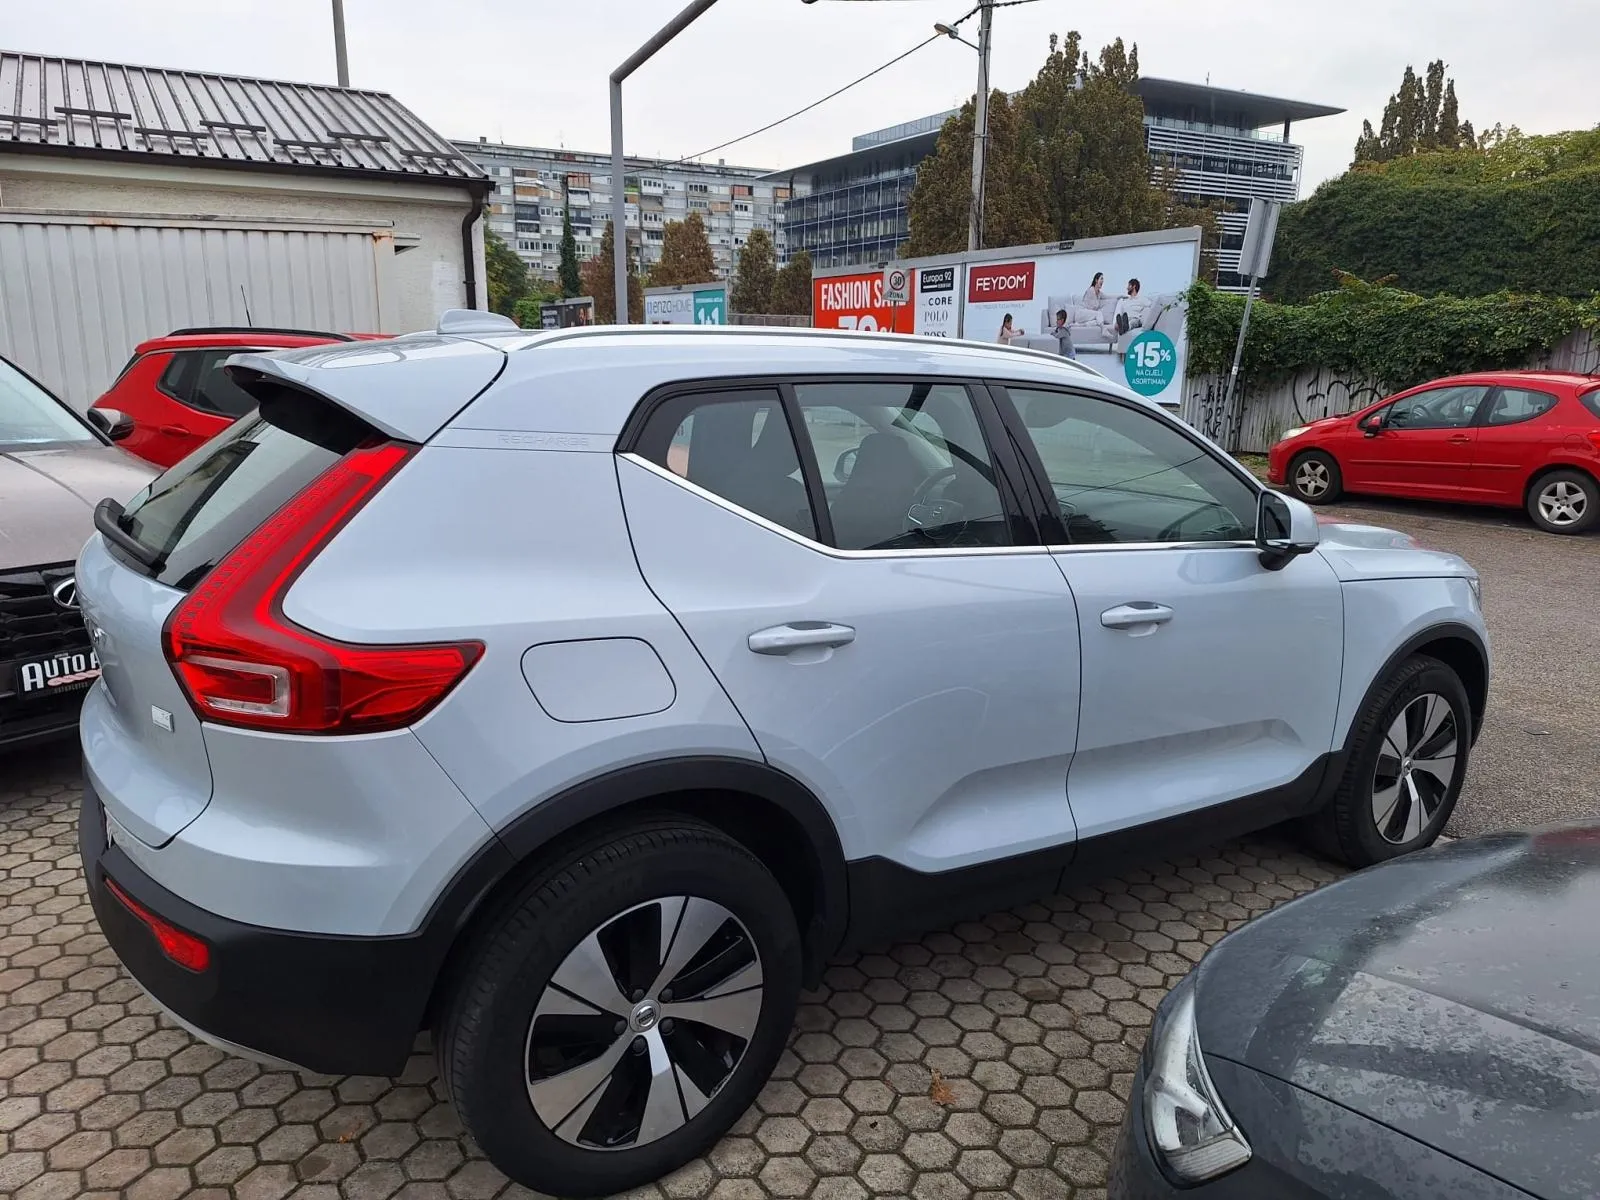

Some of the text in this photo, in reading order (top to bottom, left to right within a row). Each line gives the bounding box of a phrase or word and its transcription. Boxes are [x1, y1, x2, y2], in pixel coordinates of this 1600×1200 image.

[892, 275, 902, 286] 30
[923, 271, 952, 284] Europa 92
[976, 274, 1027, 291] FEYDOM
[821, 280, 870, 311] FASHION
[889, 291, 904, 299] ZONA
[928, 296, 953, 306] CORE
[924, 310, 949, 322] POLO
[1129, 341, 1171, 368] -15%
[497, 434, 590, 447] RECHARGE
[21, 654, 86, 692] AUTO
